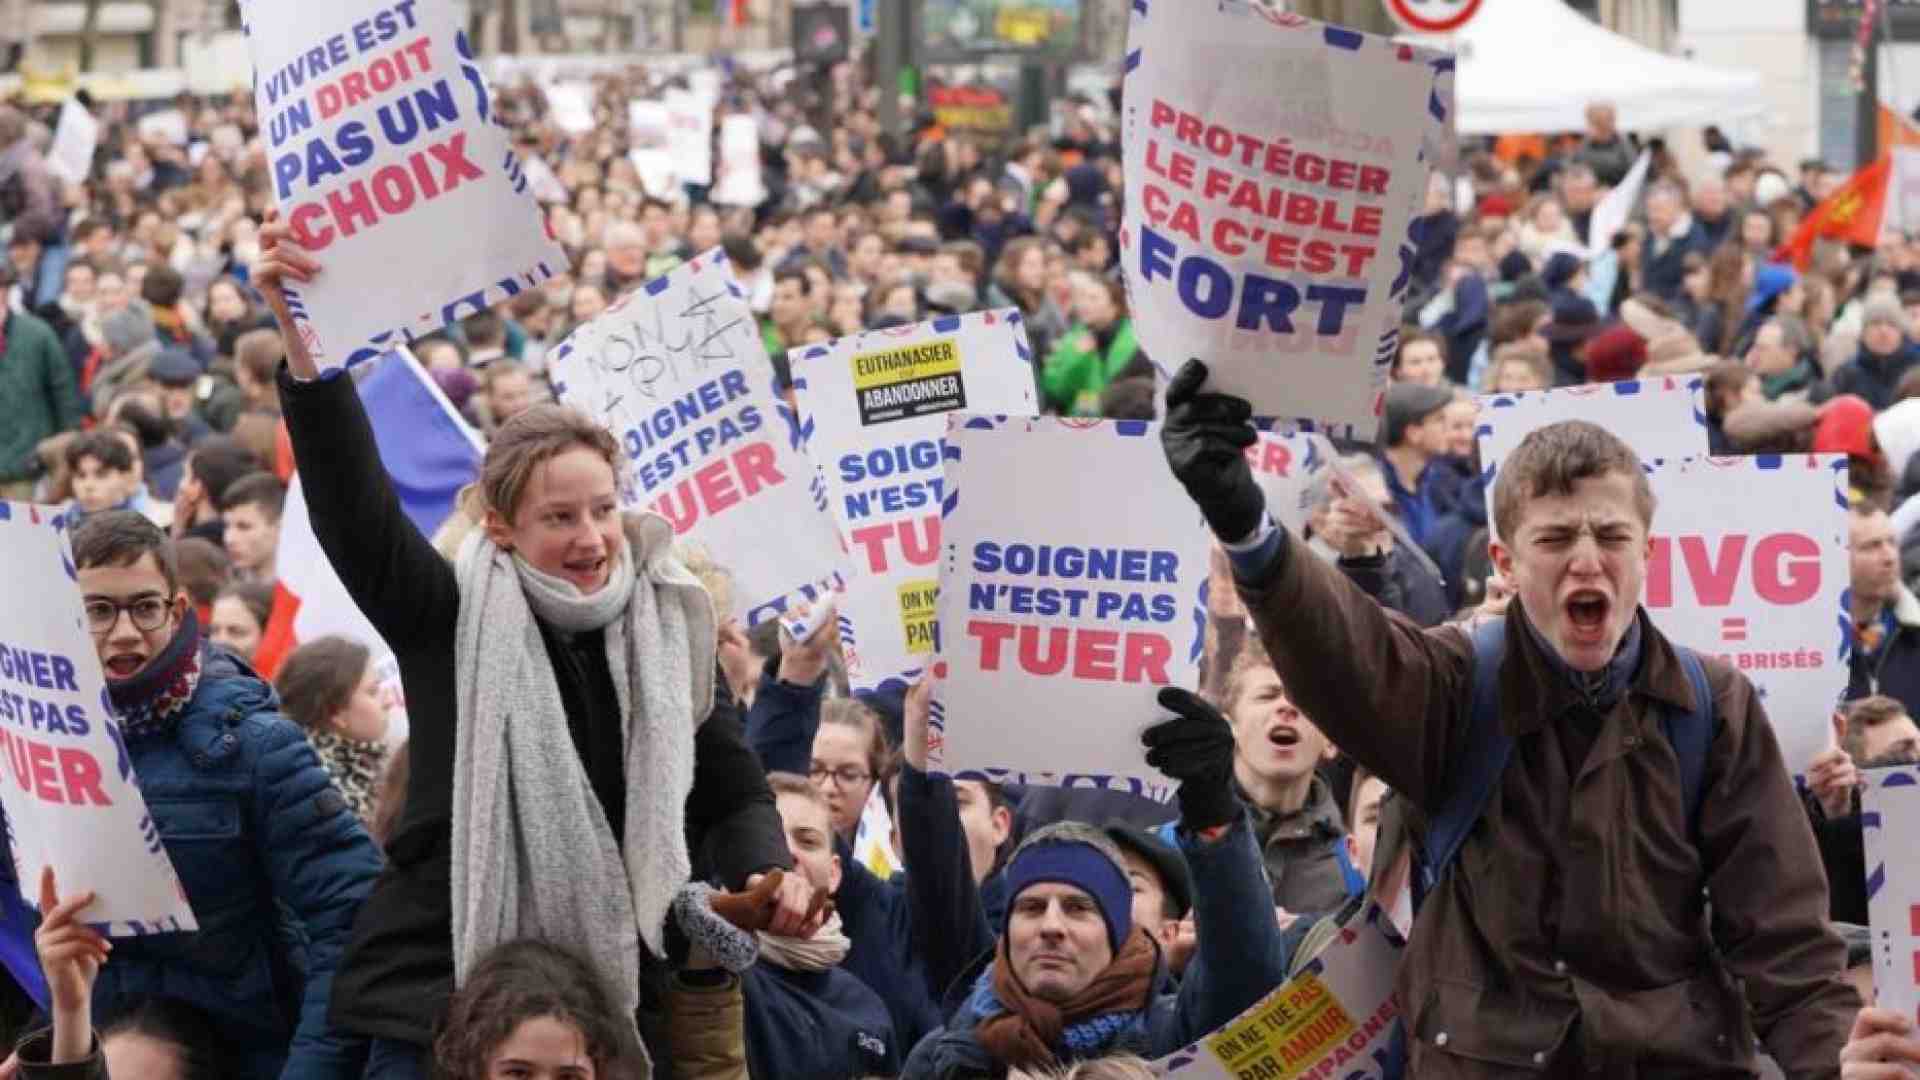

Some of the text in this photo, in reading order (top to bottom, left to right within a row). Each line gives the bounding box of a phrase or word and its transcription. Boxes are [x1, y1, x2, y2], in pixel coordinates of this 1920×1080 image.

[265, 0, 416, 104] VIVRE EST
[270, 36, 431, 147] UN DROIT
[275, 79, 459, 200] PAS UN
[1151, 99, 1390, 195] PROTÉGER
[289, 131, 485, 251] CHOIX
[1145, 140, 1384, 236] LE FAIBLE
[1143, 183, 1377, 278] ÇA C'EST
[1139, 224, 1367, 336] FORT
[856, 342, 954, 376] EUTHANASIER
[695, 405, 762, 455] PAS
[649, 442, 785, 535] UER
[969, 584, 1175, 622] N'EST PAS
[973, 541, 1179, 582] SOIGNER
[1646, 532, 1821, 608] IVG
[967, 620, 1172, 685] TUER
[28, 698, 90, 736] PAS
[1216, 1037, 1242, 1060] ON
[1262, 1003, 1293, 1032] TUE
[1238, 1054, 1281, 1080] PAR
[1280, 1005, 1347, 1066] AMOUR
